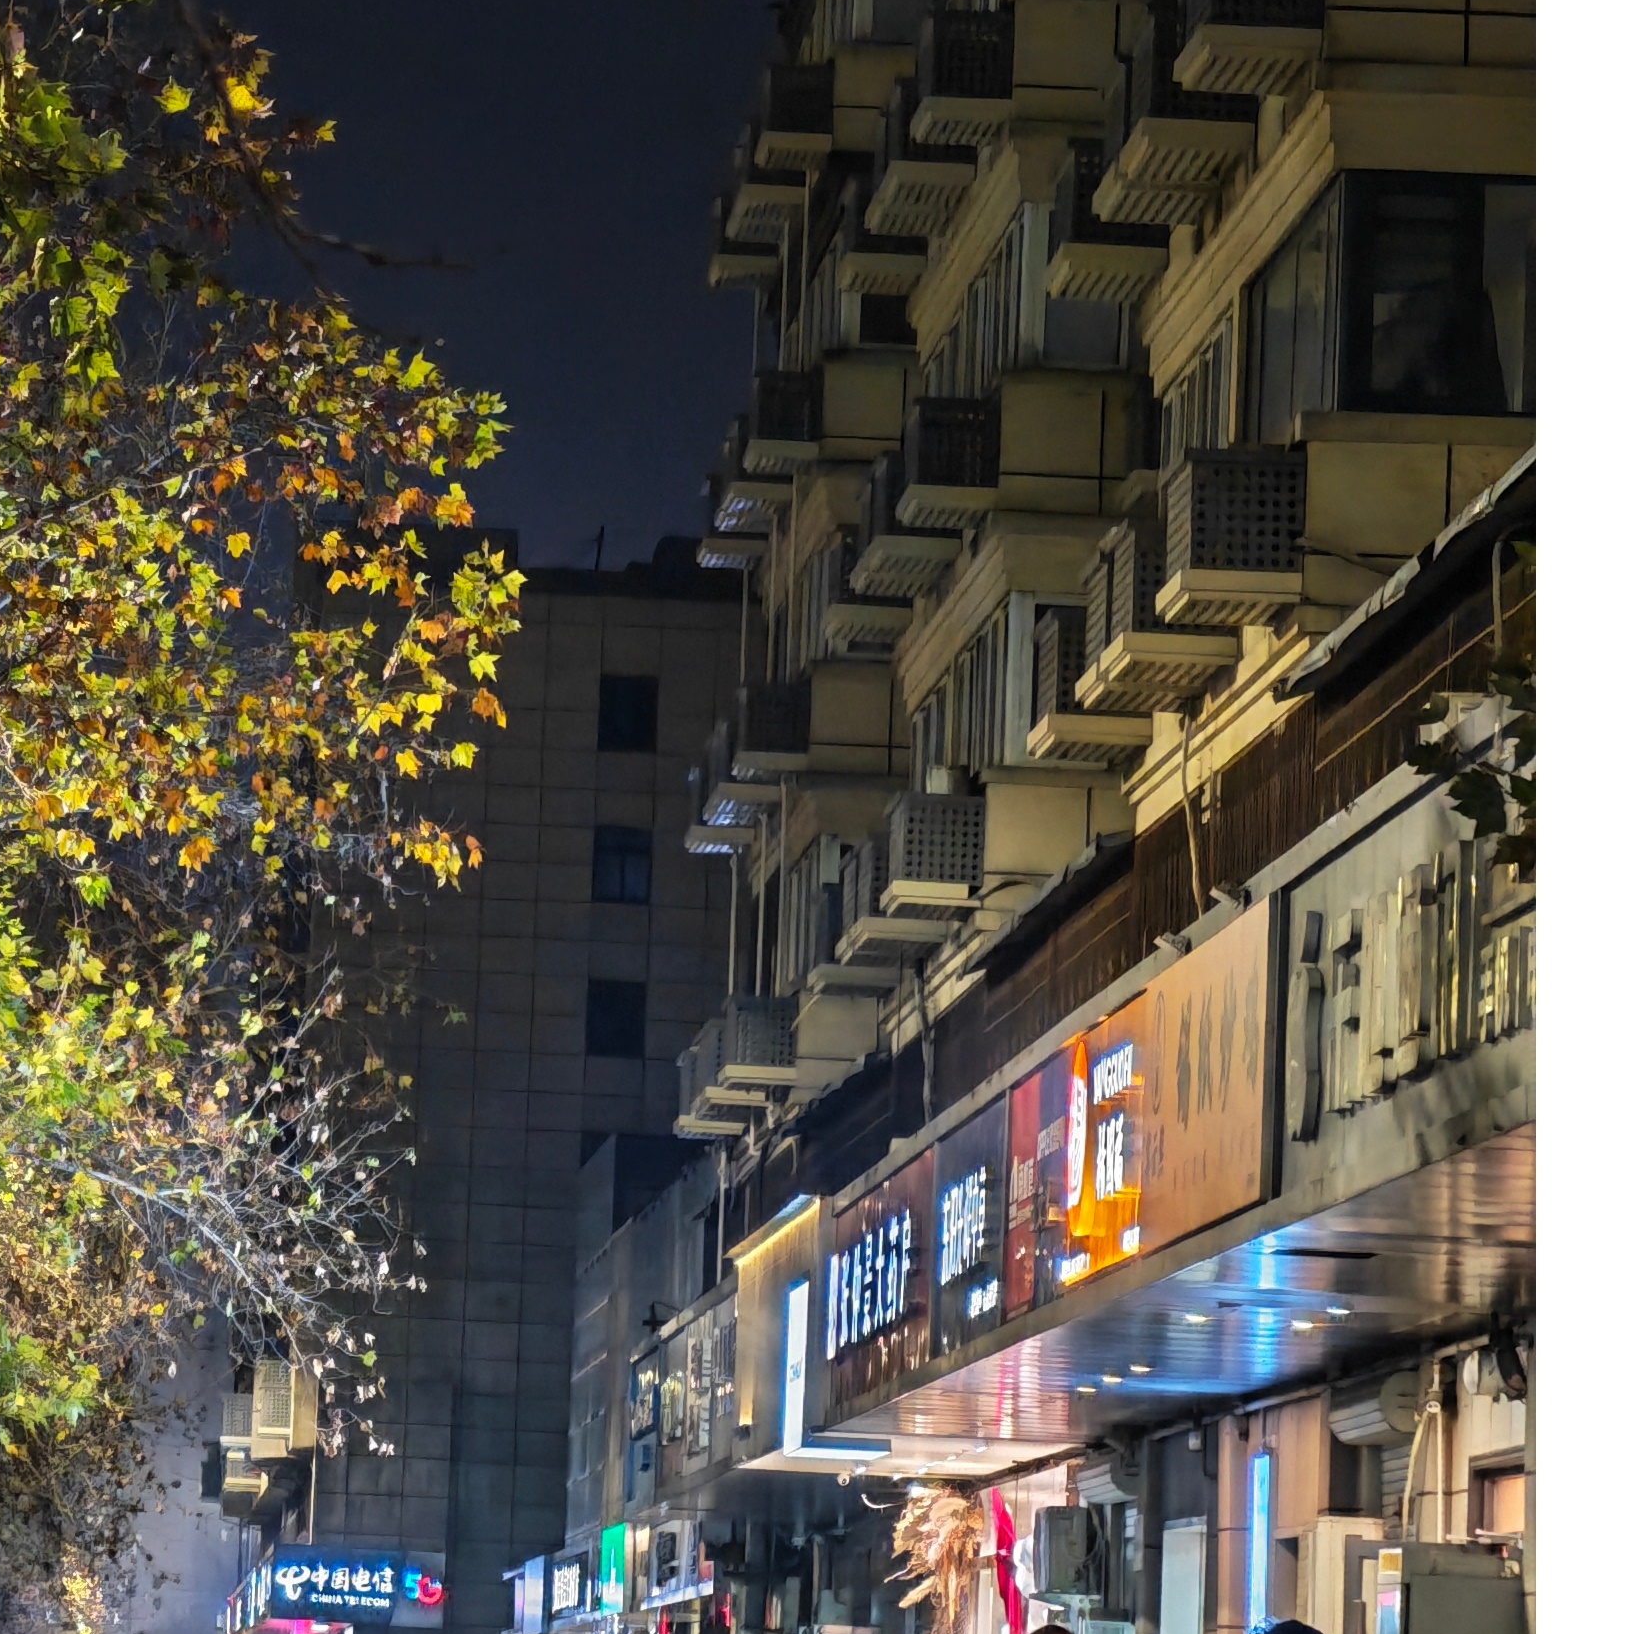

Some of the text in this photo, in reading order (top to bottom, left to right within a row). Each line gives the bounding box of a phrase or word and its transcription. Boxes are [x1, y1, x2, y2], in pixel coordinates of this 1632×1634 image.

[311, 1563, 395, 1593] 中国电信
[405, 1573, 443, 1606] 5G
[311, 1593, 390, 1607] CHINA TELECOM
